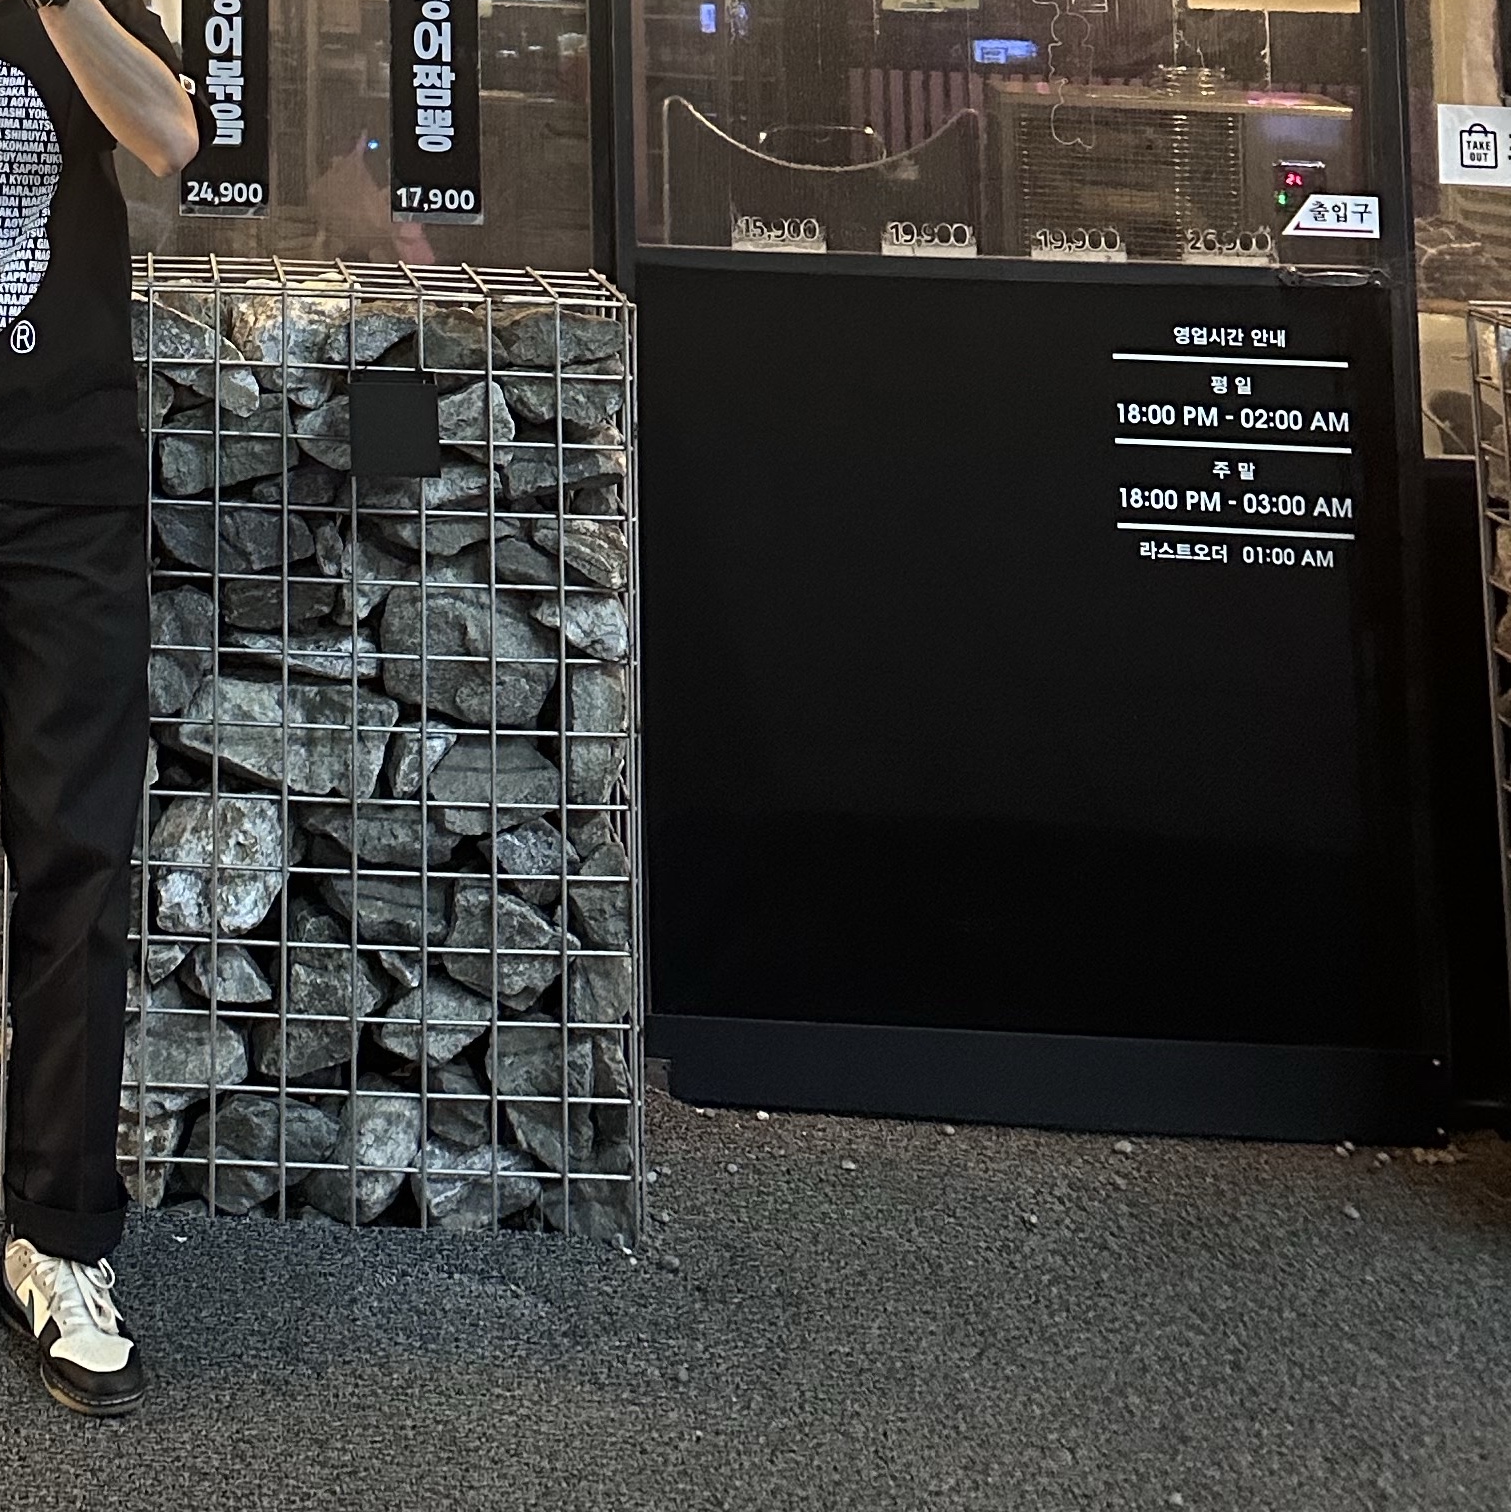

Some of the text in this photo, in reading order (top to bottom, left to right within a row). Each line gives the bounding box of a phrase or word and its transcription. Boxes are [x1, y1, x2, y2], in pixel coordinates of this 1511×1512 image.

[4, 129, 48, 142] SHIBUYA
[1466, 140, 1491, 151] TAKE
[1469, 152, 1489, 163] OUT
[9, 174, 41, 185] KYOTO
[12, 163, 58, 175] SAPPORO
[187, 182, 263, 204] 24,900
[397, 188, 475, 212] 17,900
[1309, 200, 1372, 224] 출입구
[889, 221, 969, 247] 19,900
[1036, 228, 1121, 251] 19,900
[1173, 327, 1286, 348] 영업시간 안내
[1117, 403, 1176, 425] 18:00
[1183, 405, 1218, 427] PM
[1240, 408, 1303, 431] 02:00
[1310, 412, 1350, 433] AM
[1119, 487, 1178, 510] 18:00
[1186, 491, 1222, 512] PM
[1243, 493, 1306, 515] 03:00
[1313, 497, 1353, 518] AM
[1139, 541, 1334, 568] 라스트오더 01:00 AM
